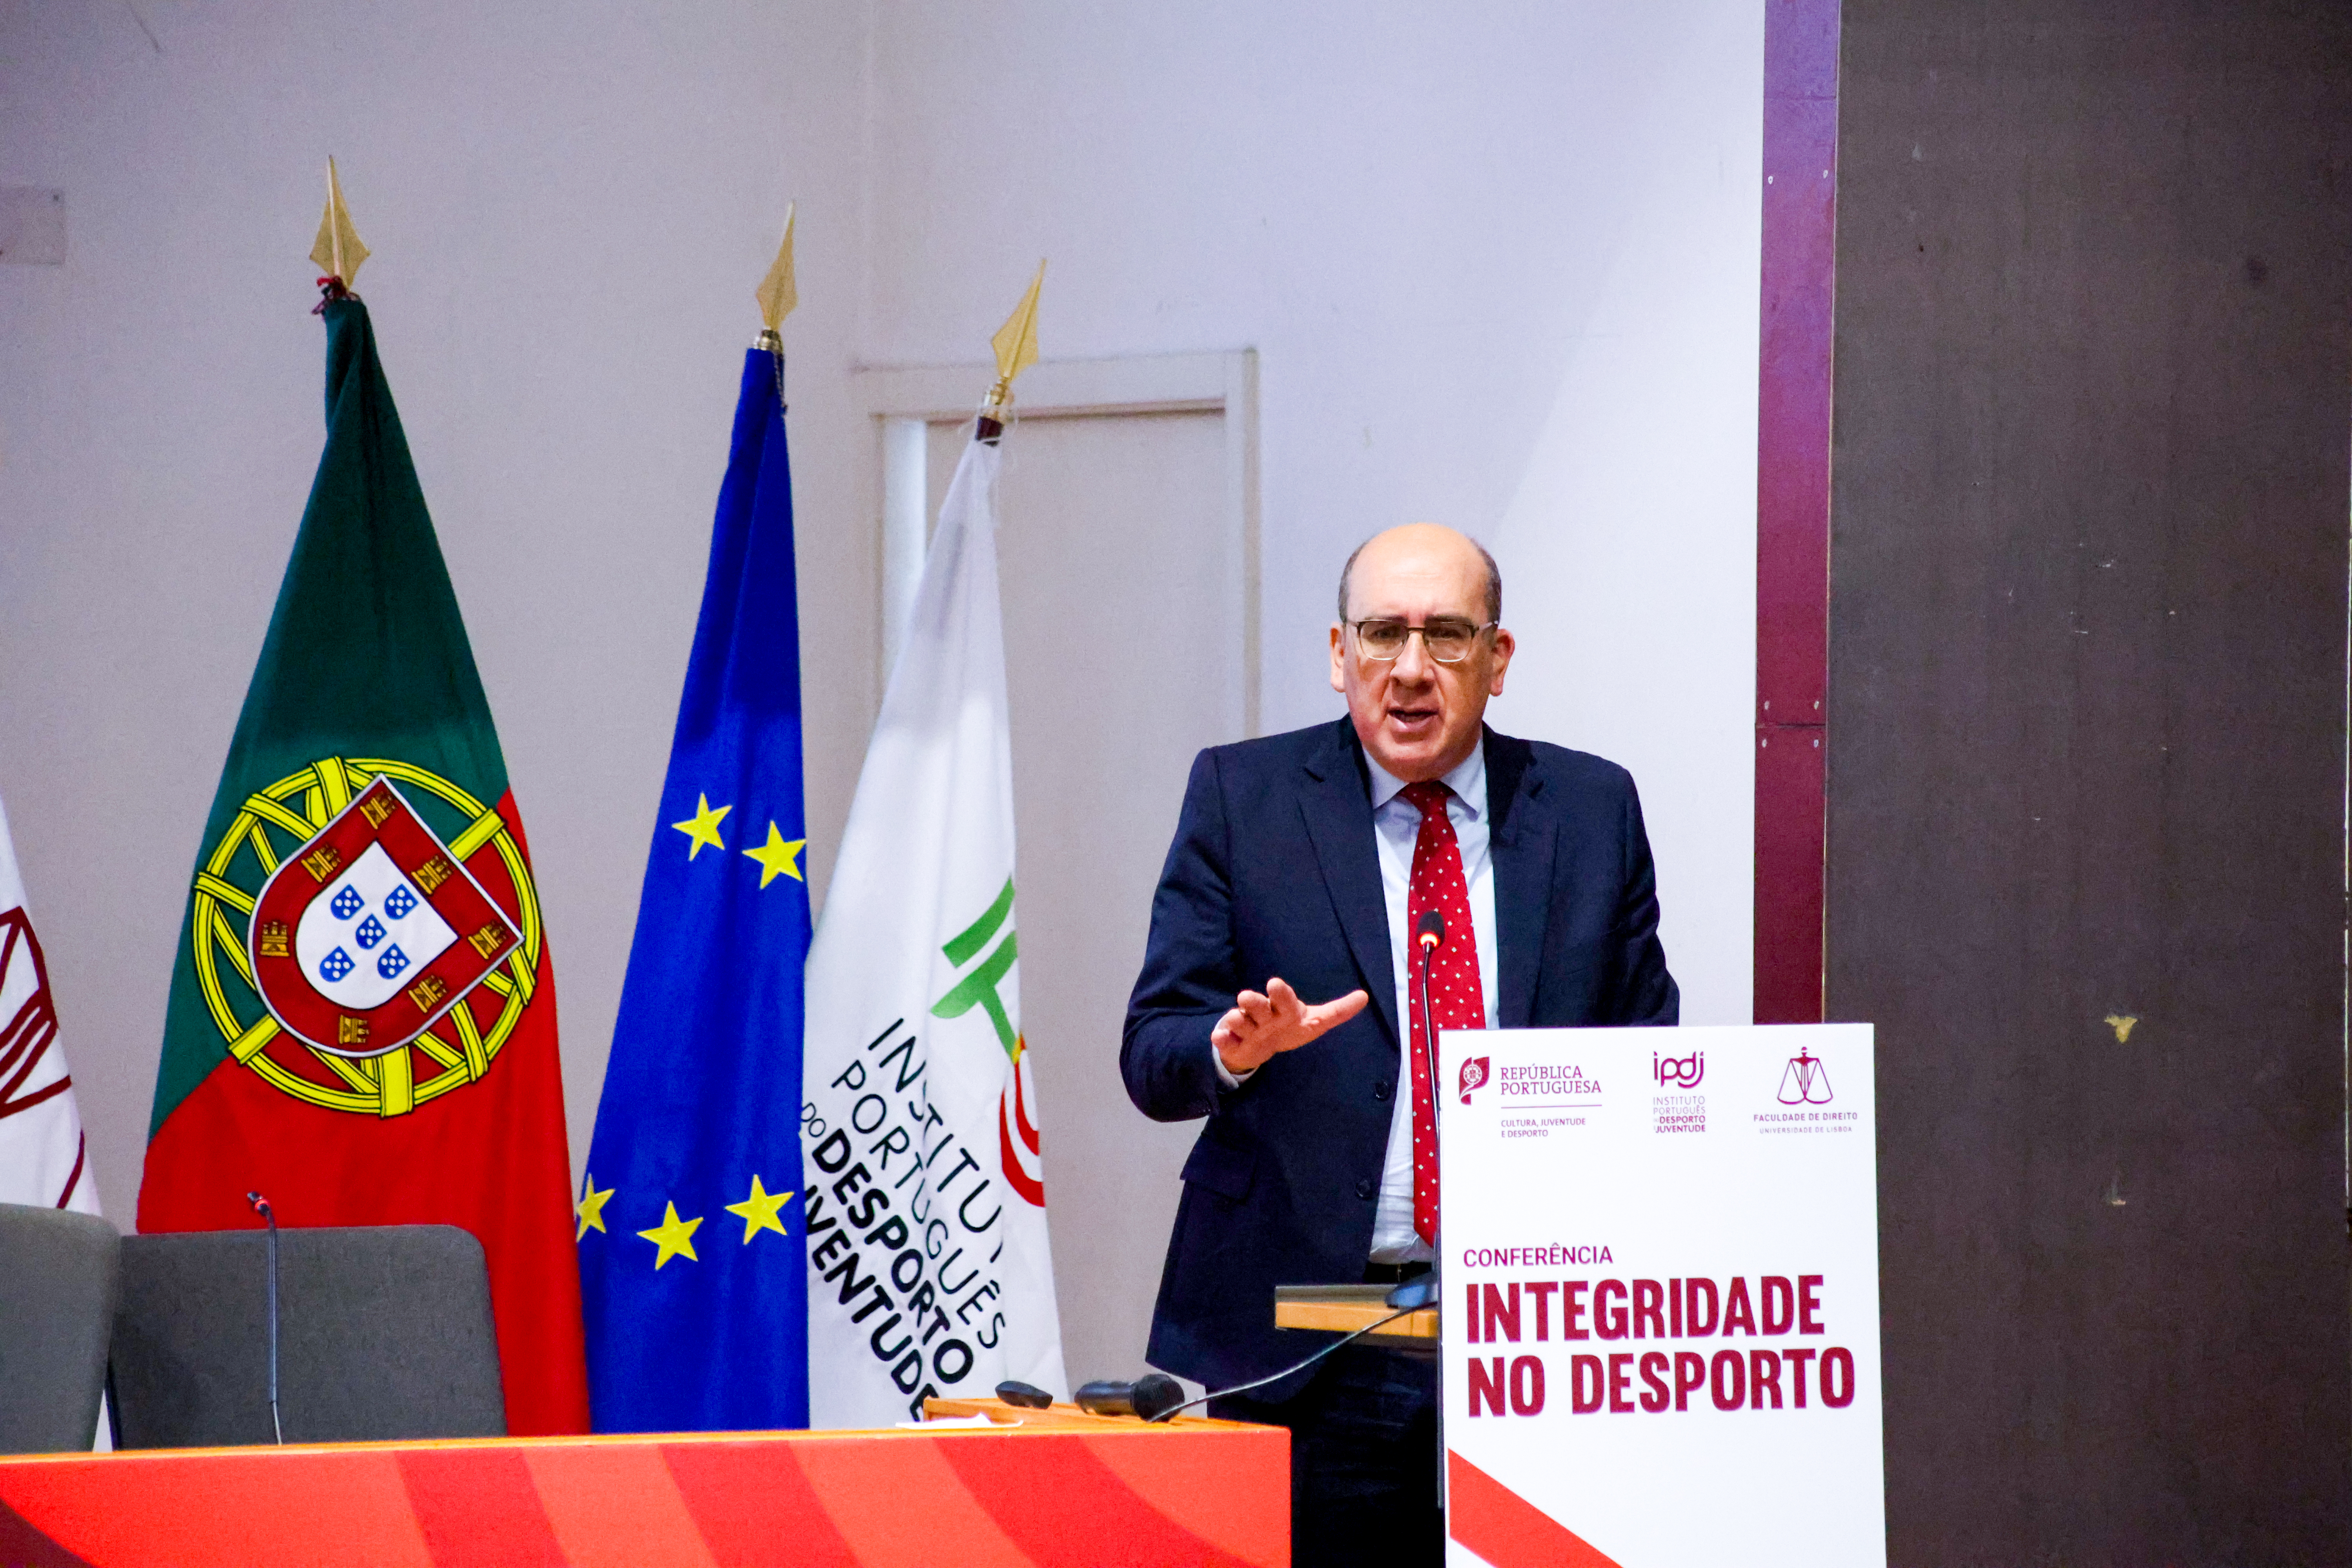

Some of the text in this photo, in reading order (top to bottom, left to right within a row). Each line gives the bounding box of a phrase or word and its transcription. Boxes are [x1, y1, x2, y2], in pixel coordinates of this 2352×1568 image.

[1500, 1063, 1583, 1080] REPÚBLICA
[1653, 1051, 1704, 1089] ipdj
[1501, 1080, 1602, 1095] PORTUGUESA
[1653, 1096, 1705, 1105] INSTITUTO
[1653, 1105, 1706, 1115] PORTUGUÊS
[1823, 1112, 1858, 1120] DIREITO
[1501, 1118, 1586, 1128] CULTURA, JUVENTUDE
[1659, 1115, 1706, 1124] DESPORTO
[1507, 1129, 1548, 1138] DESPORTO
[1655, 1124, 1706, 1133] JUVENTUDE
[868, 1018, 1004, 1263] INSTITU
[831, 1059, 1006, 1349] PORTUGUÊS
[802, 1102, 973, 1384] DO DESPORTO
[1463, 1242, 1613, 1267] CONFERÊNCIA
[1466, 1274, 1825, 1344] INTEGRIDADE
[1468, 1347, 1855, 1418] NO DESPORTO
